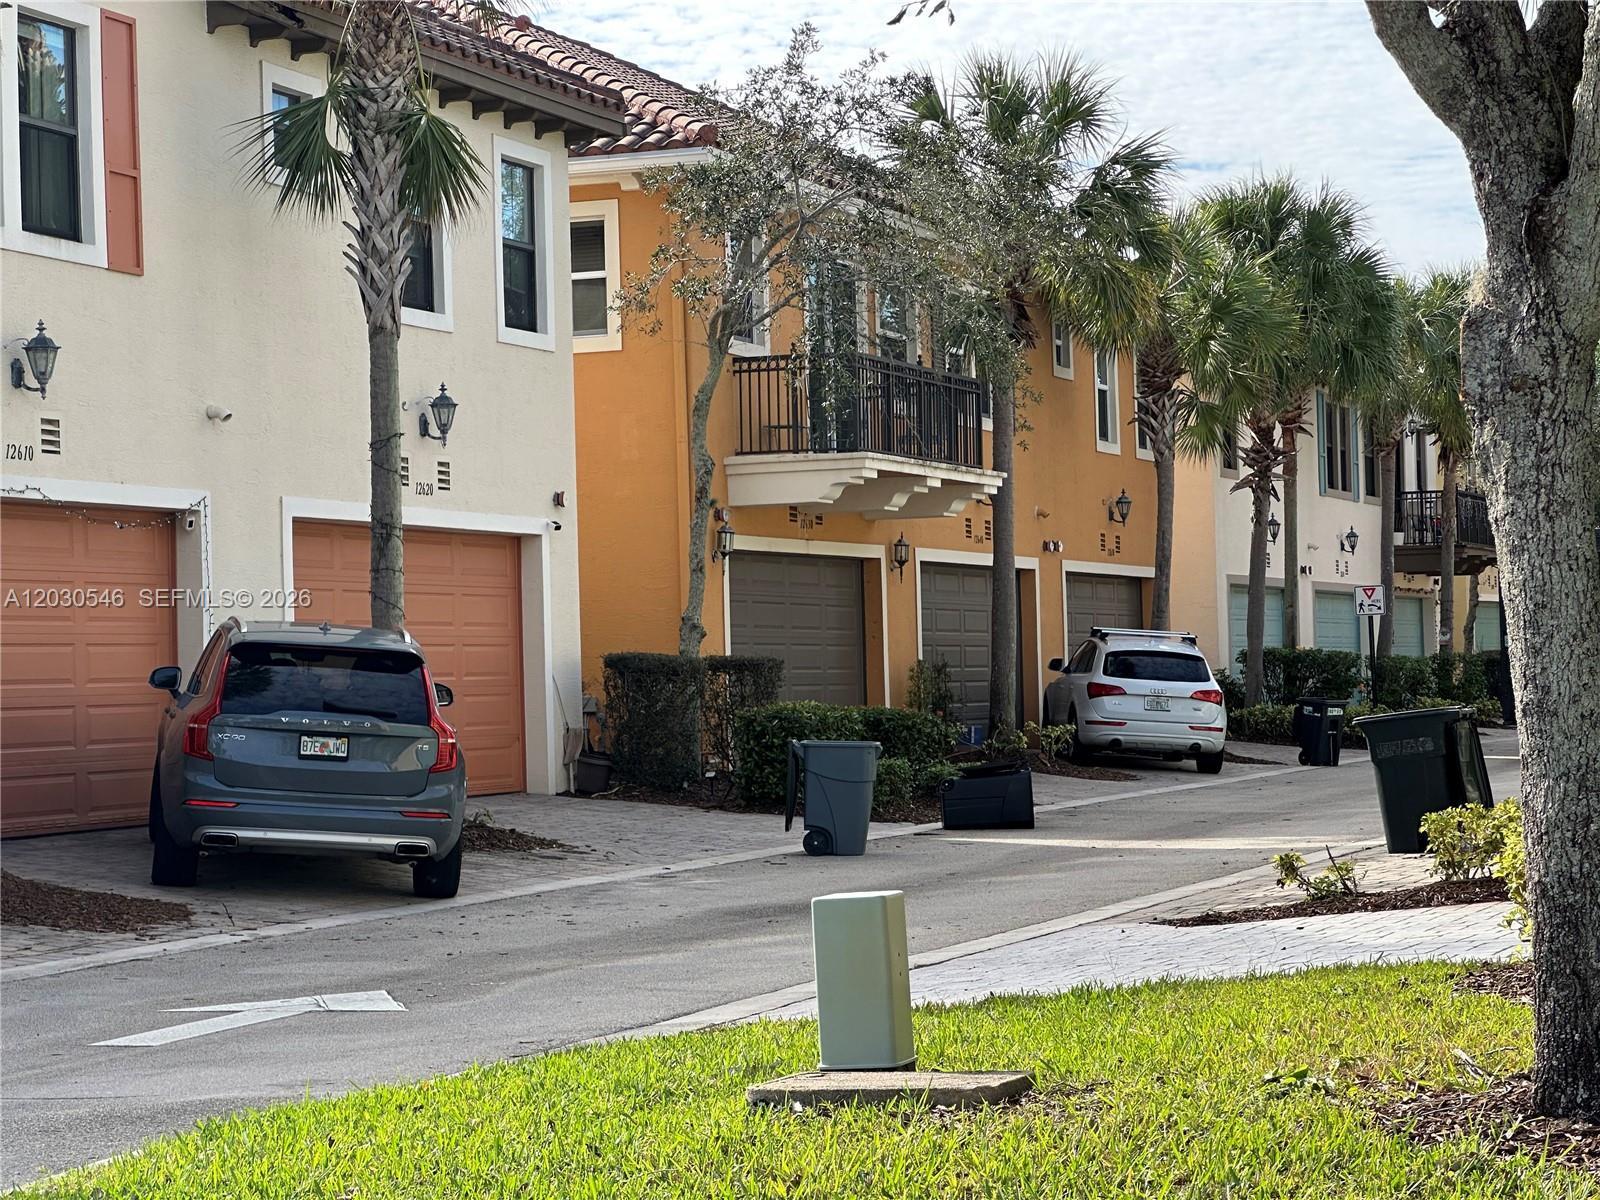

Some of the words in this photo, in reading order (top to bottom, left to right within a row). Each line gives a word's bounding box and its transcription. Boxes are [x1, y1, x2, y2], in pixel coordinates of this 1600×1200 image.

[5, 443, 34, 461] 12610
[415, 481, 434, 496] 12620
[280, 716, 371, 728] VOLVO
